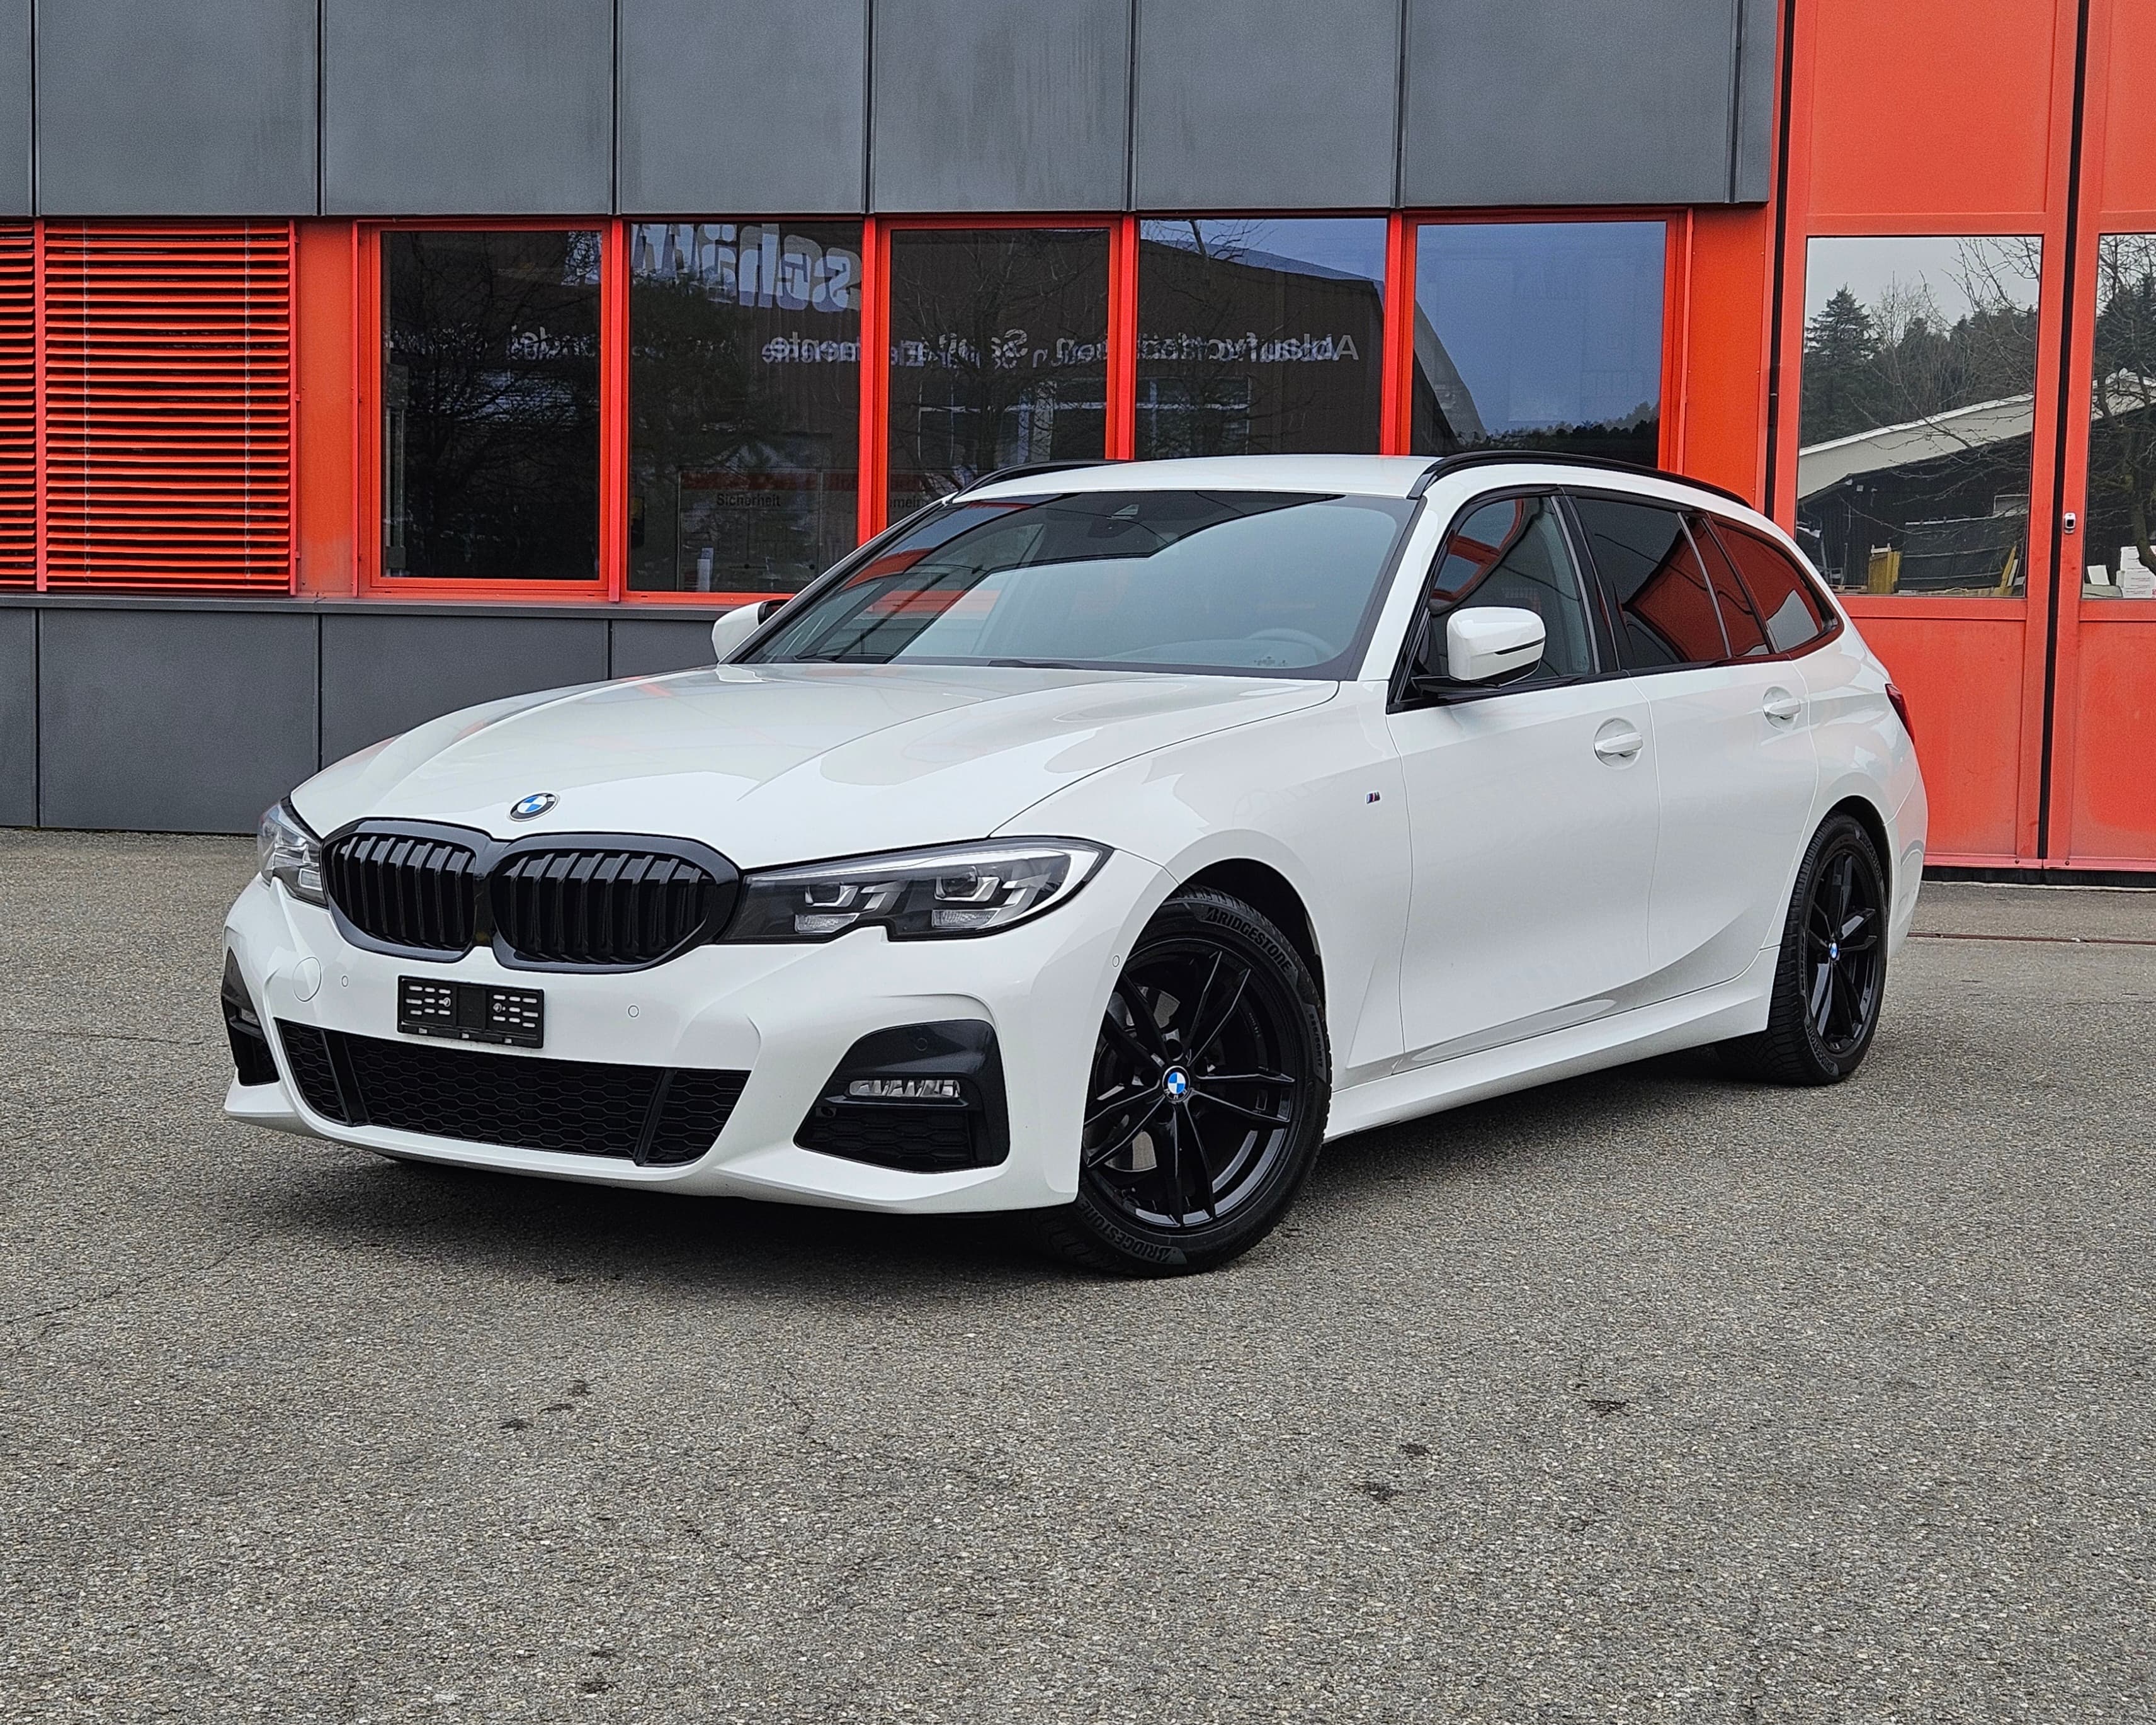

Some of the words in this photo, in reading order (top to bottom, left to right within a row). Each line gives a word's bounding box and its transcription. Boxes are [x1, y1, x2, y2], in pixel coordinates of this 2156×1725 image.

[716, 492, 781, 508] Sicherheit
[1206, 907, 1292, 973] BRIDGESTONE
[1079, 1200, 1172, 1261] BRIDGESTONE
